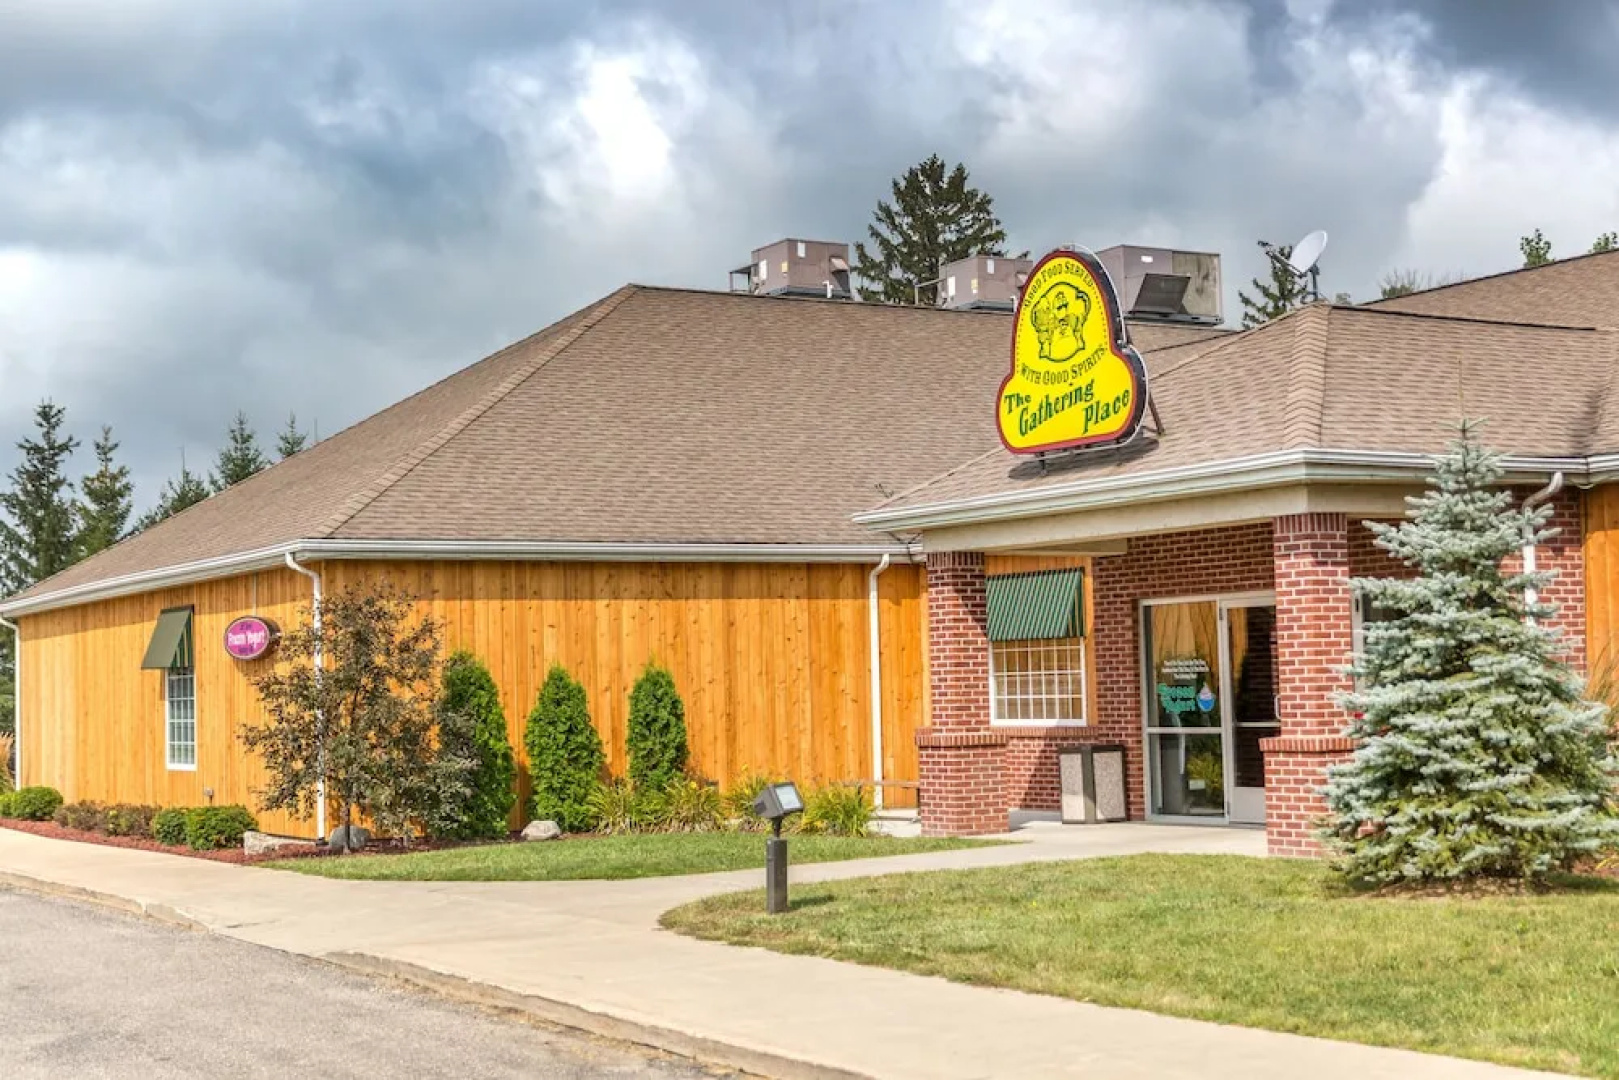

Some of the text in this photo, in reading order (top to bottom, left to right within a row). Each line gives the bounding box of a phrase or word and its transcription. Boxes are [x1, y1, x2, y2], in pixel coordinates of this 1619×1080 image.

[1041, 263, 1063, 283] FOOD
[1065, 260, 1094, 288] SERVED
[1021, 345, 1106, 386] WITH GOOD SPIRITS
[1004, 392, 1032, 414] The
[1019, 378, 1095, 437] Gathering
[1081, 389, 1131, 435] Place
